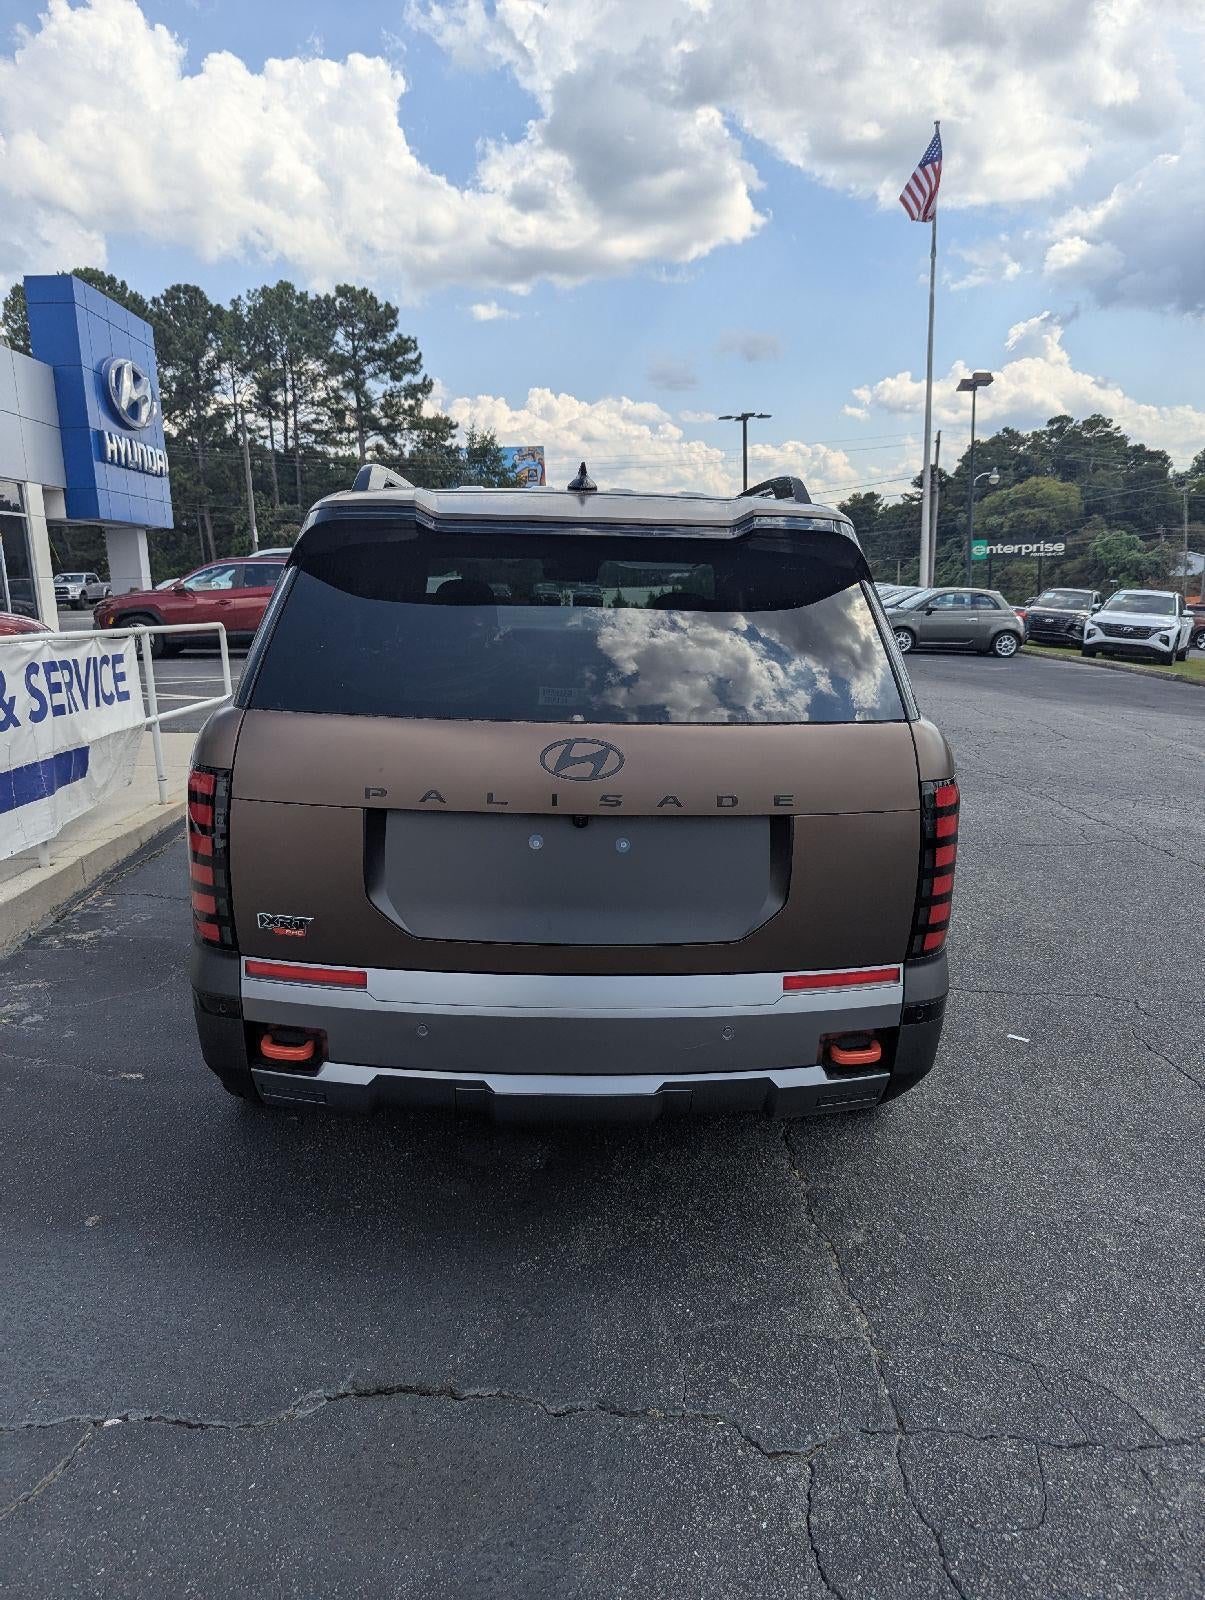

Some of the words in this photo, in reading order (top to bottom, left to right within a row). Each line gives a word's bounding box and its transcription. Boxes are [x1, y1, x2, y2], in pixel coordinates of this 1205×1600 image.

[104, 431, 169, 477] HYUNDAI
[972, 541, 1065, 556] enterprise
[25, 653, 131, 724] SERVICE
[364, 787, 794, 808] PALISADE
[257, 912, 315, 930] XRT
